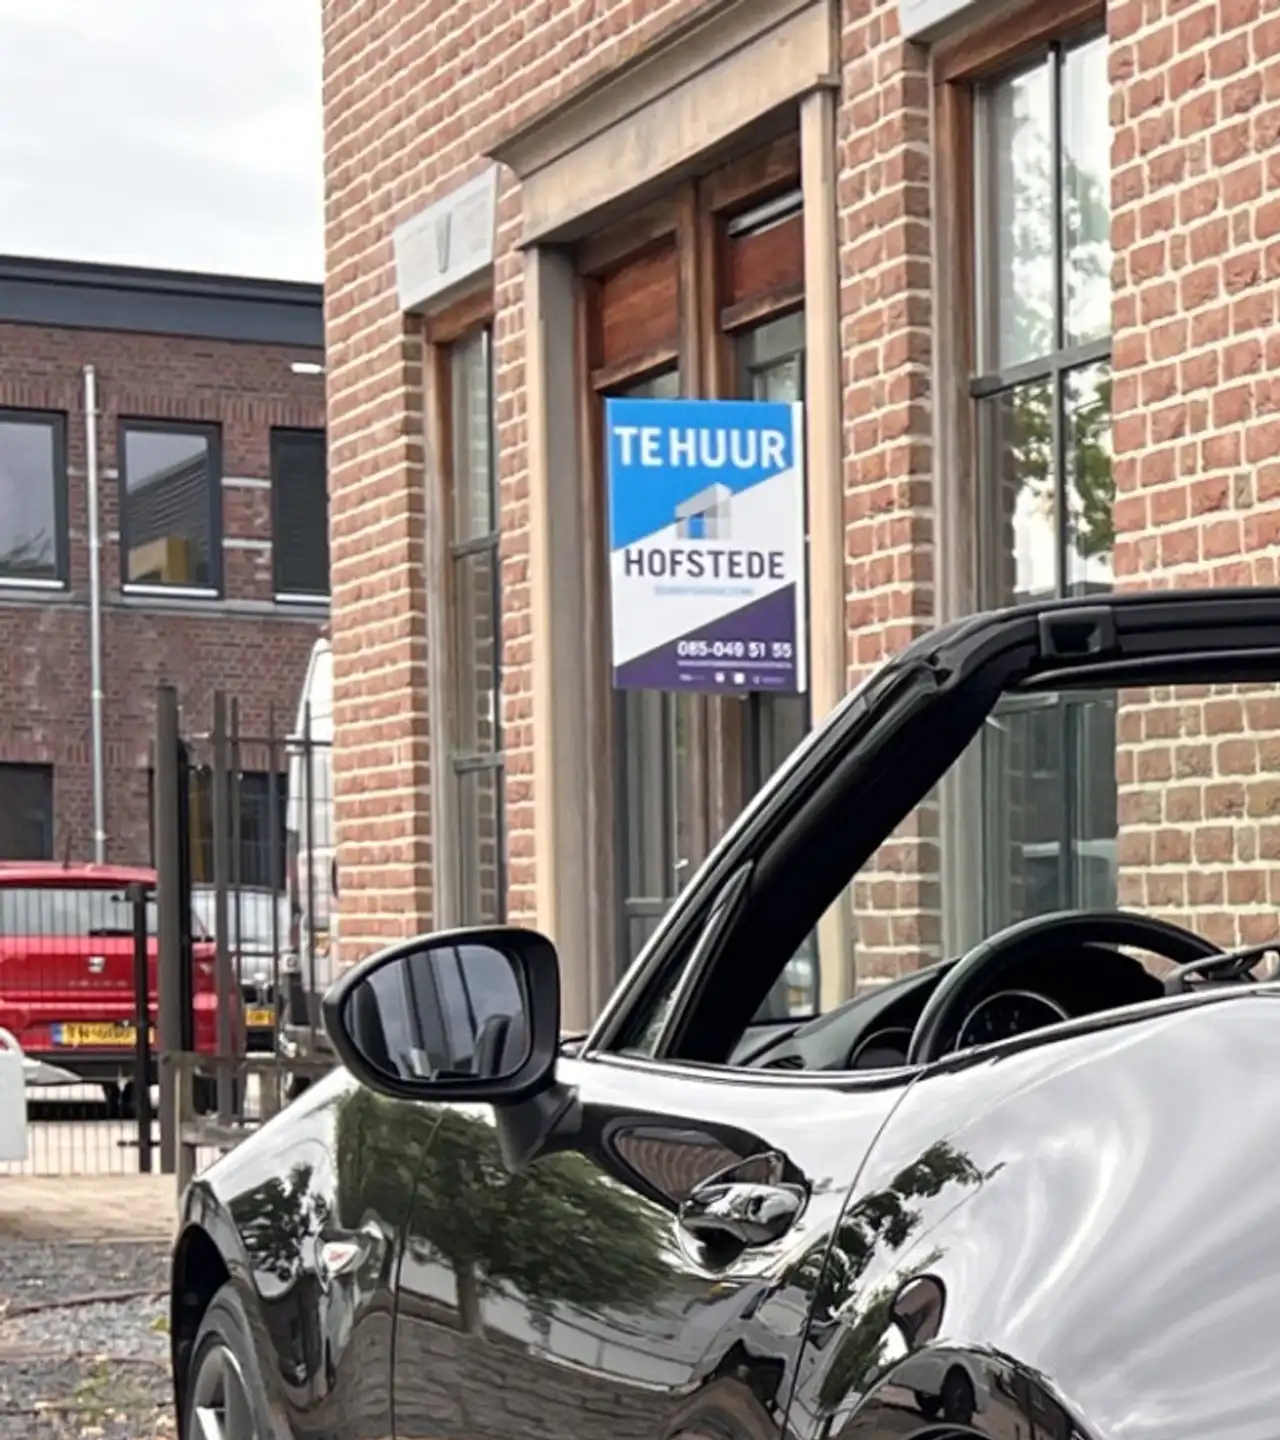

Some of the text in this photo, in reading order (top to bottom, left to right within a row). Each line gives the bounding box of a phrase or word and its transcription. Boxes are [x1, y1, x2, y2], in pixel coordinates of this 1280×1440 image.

[613, 426, 786, 469] TE HUUR
[624, 548, 785, 579] HOFSTEDE
